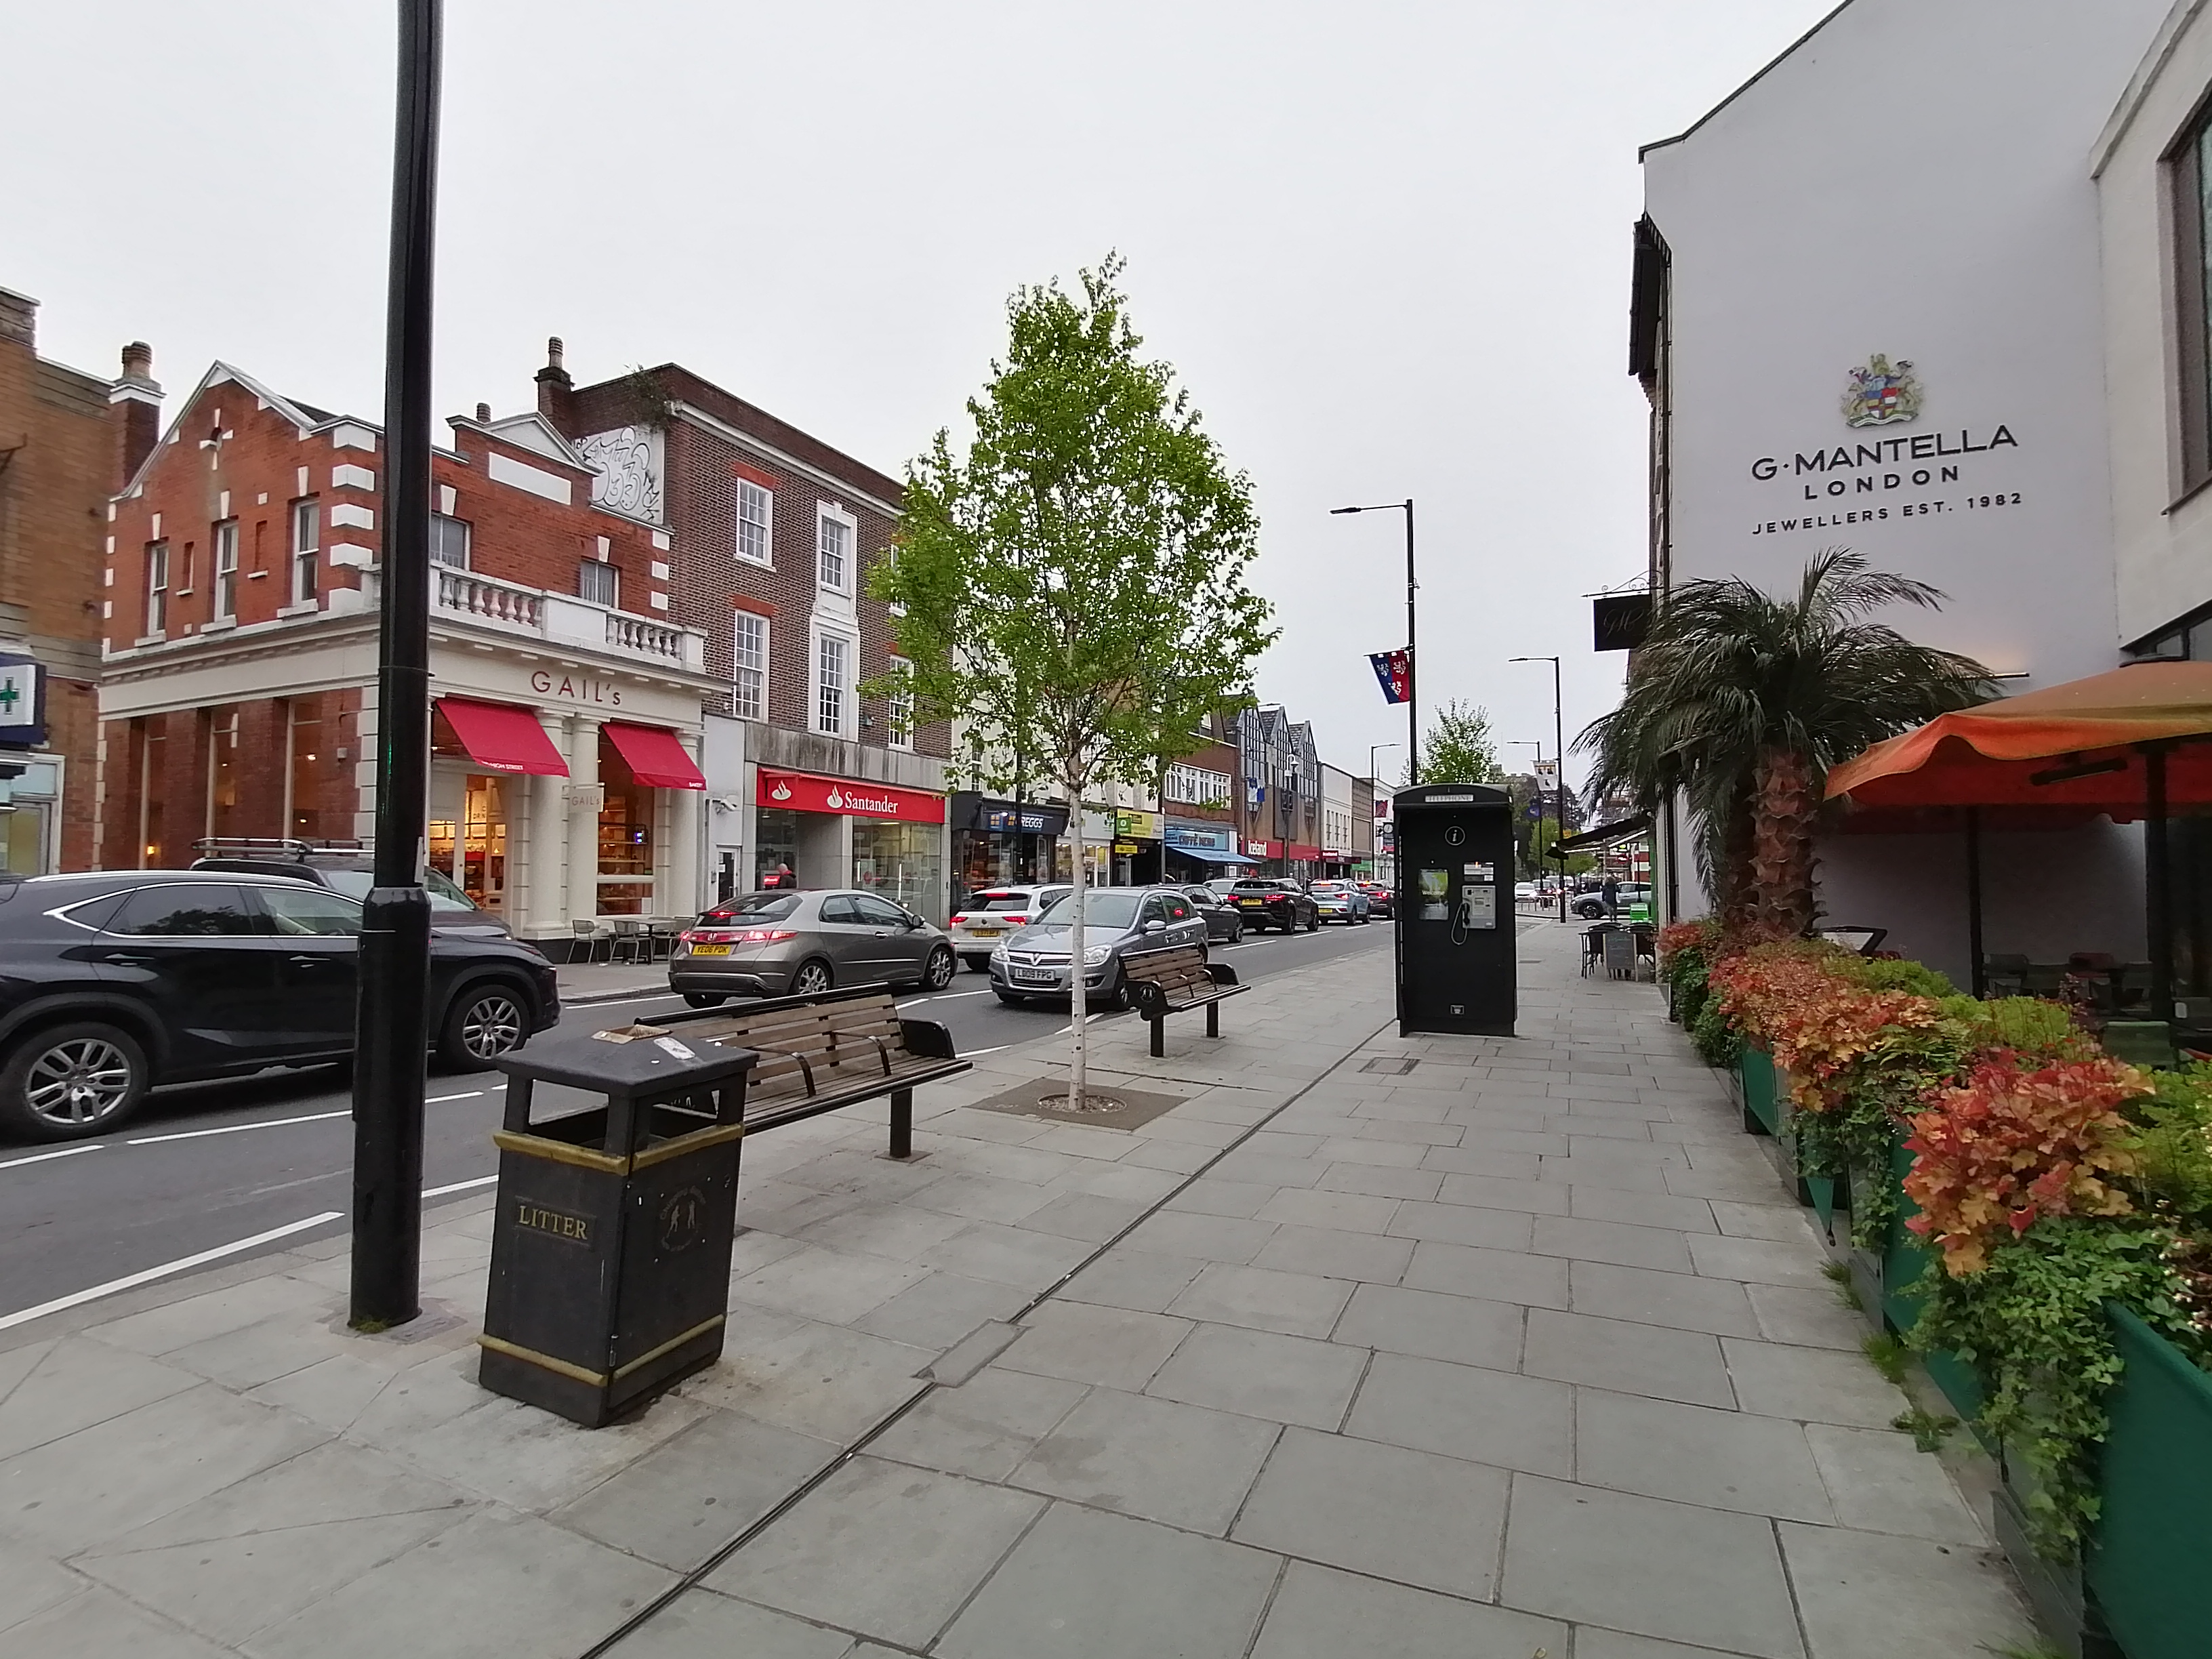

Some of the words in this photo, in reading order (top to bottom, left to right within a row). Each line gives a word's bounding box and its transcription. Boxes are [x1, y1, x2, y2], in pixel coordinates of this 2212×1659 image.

[1804, 465, 1959, 500] LONDON
[1753, 507, 1889, 535] JEWELLERS
[1902, 500, 1953, 516] EST.
[1967, 492, 2022, 510] 1982
[531, 670, 621, 705] GAIL's
[571, 794, 600, 806] GAIL's
[844, 791, 899, 813] Santander
[1248, 840, 1267, 857] Iceland
[518, 1205, 588, 1240] LITTER
